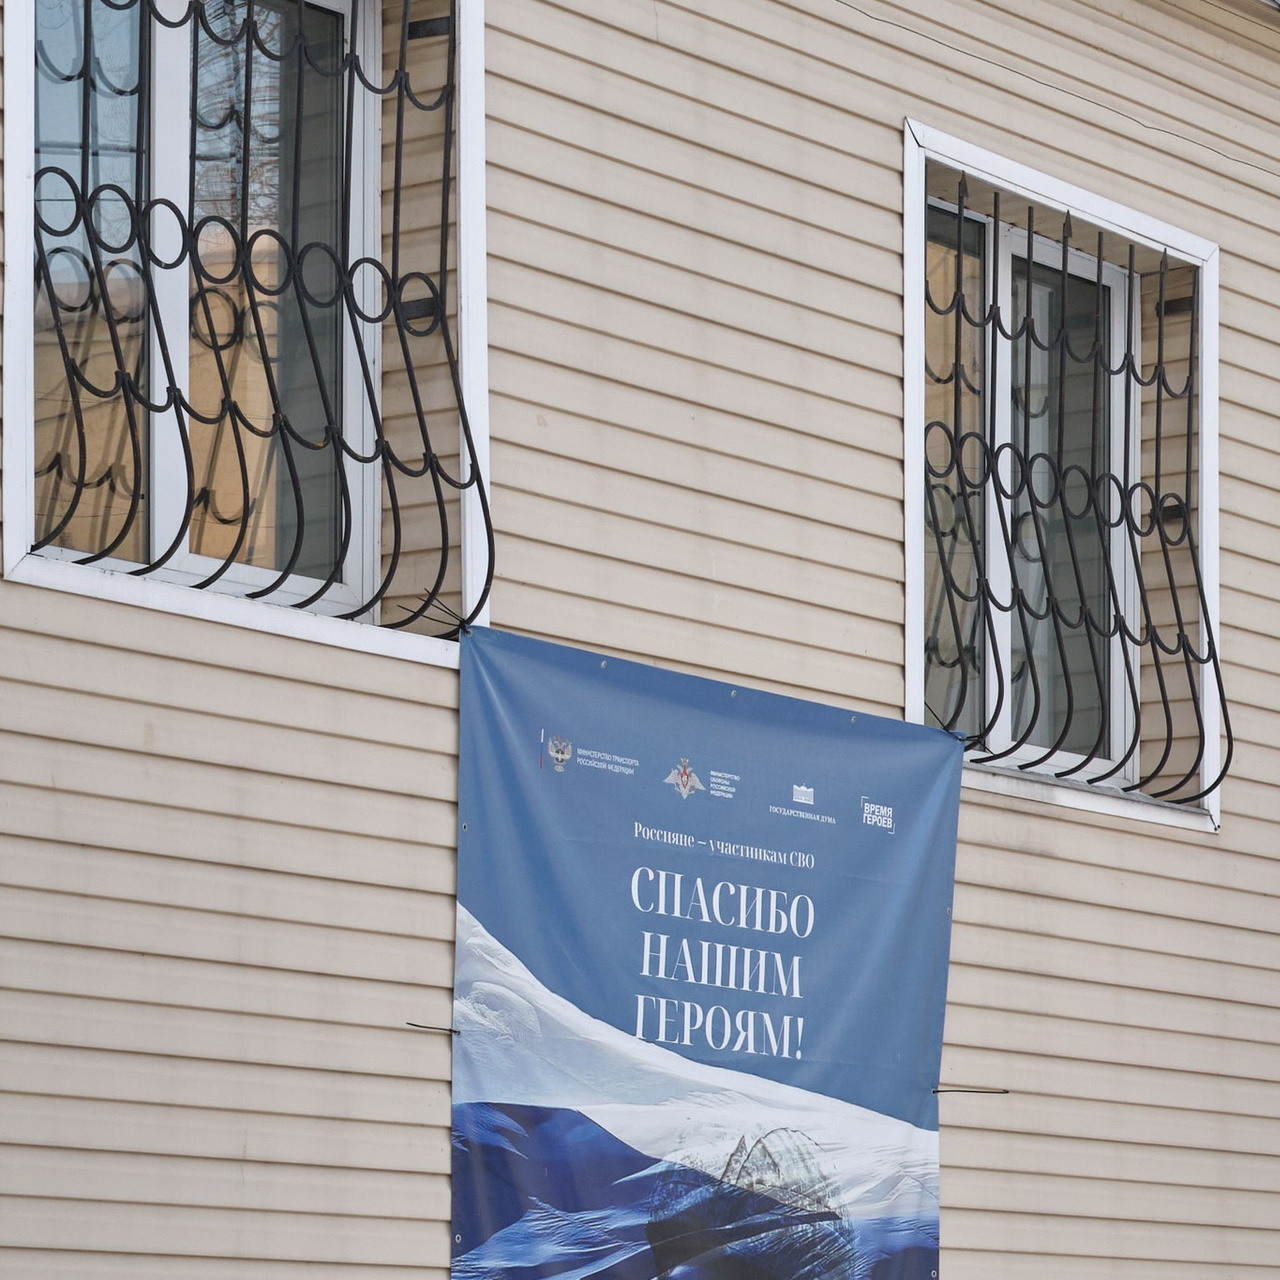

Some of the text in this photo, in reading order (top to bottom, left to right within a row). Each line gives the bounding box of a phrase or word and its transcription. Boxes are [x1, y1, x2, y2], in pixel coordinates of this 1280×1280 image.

[819, 814, 837, 825] ДУМА
[862, 813, 893, 829] ГЕРОЕВ
[863, 802, 893, 818] ВРЕМЯ
[633, 821, 695, 849] Россияне
[709, 839, 788, 866] участникам
[789, 850, 816, 871] СВО
[630, 866, 816, 940] СПАСИБО
[639, 930, 804, 999] НАШИМ
[634, 993, 805, 1060] ГЕРОЯМ!
